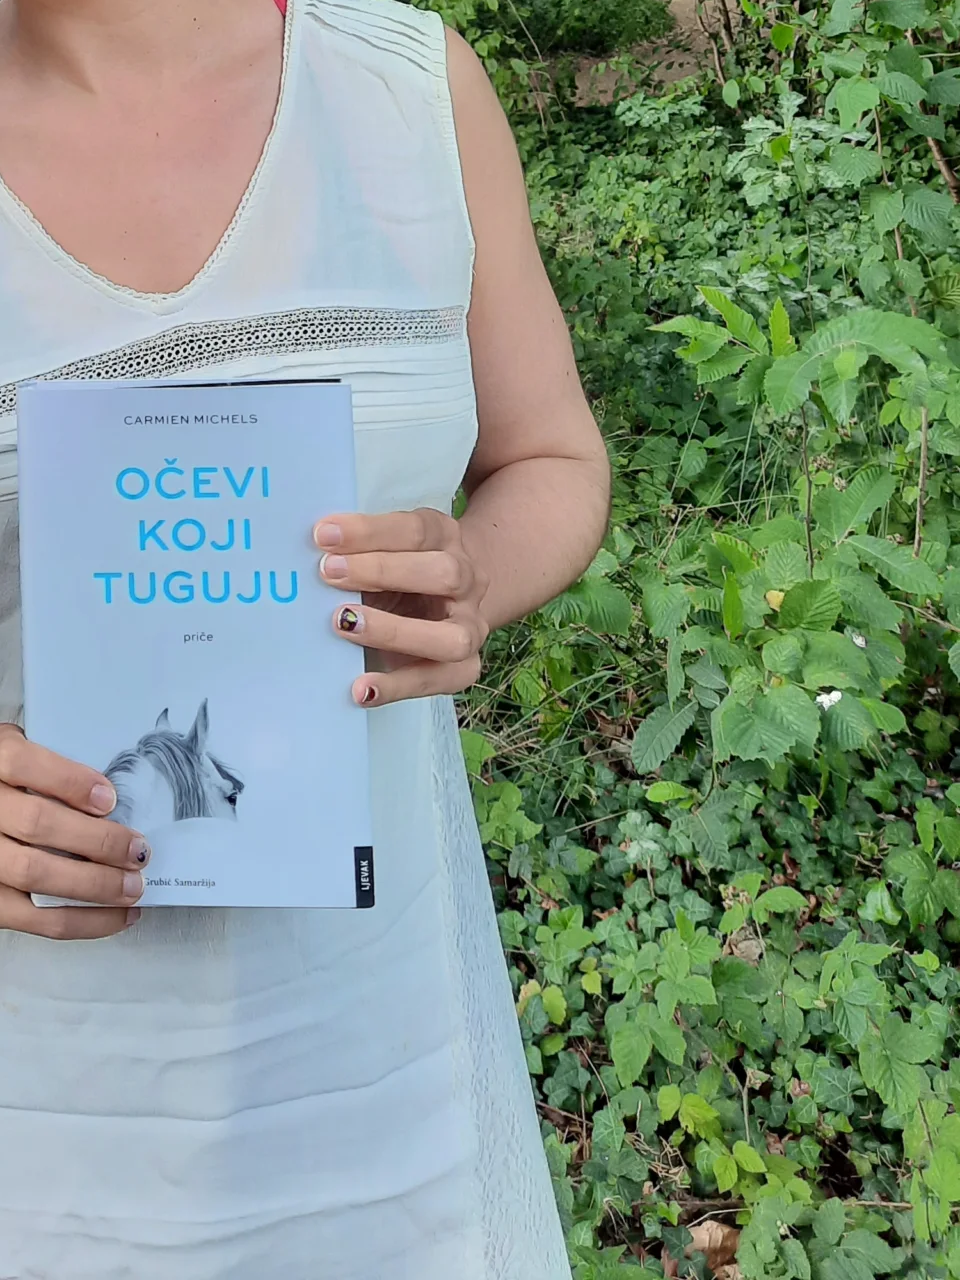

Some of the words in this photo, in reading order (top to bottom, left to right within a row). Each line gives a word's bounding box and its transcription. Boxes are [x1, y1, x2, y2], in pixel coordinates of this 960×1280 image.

[123, 415, 190, 426] CARMIEN
[194, 414, 258, 425] MICHELS
[115, 458, 270, 500] OČEVI
[139, 518, 252, 551] KOJI
[93, 570, 298, 604] TUGUJU
[183, 631, 214, 644] priče
[174, 877, 216, 888] Samaržija
[360, 860, 370, 891] LJEVAK
